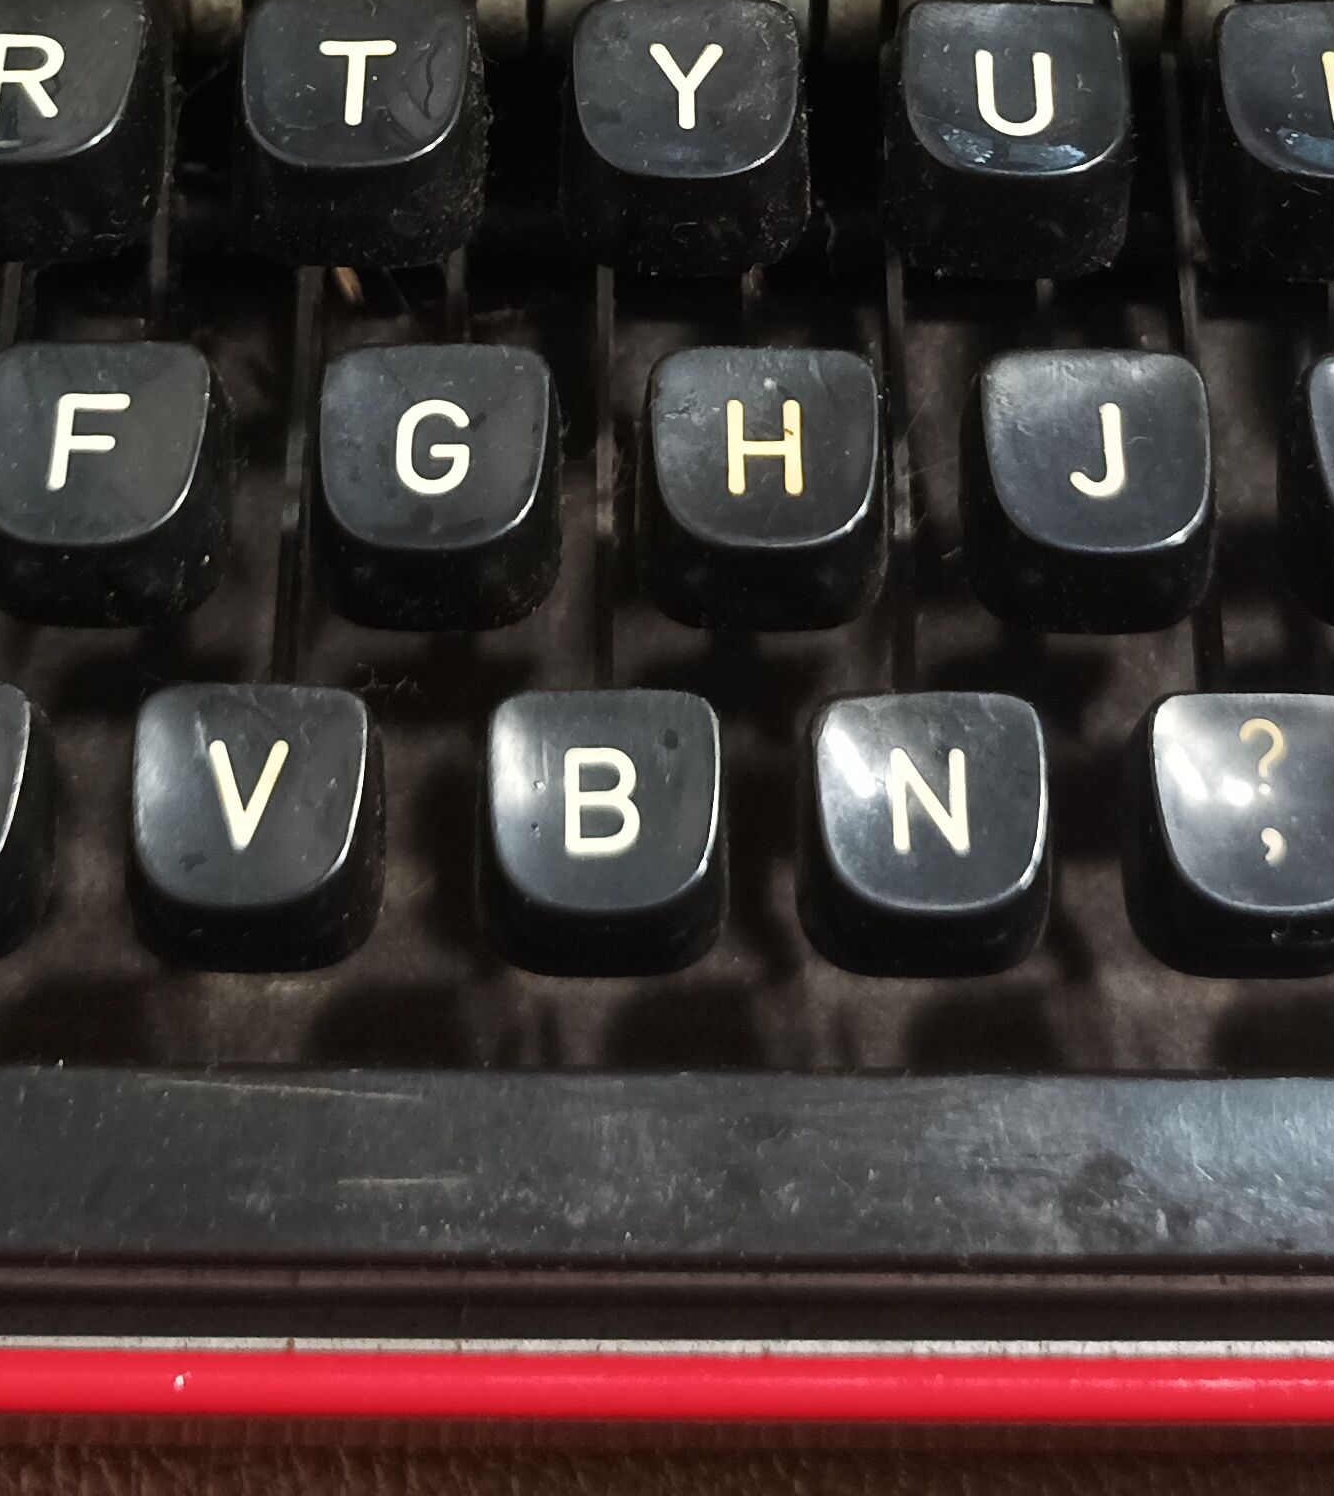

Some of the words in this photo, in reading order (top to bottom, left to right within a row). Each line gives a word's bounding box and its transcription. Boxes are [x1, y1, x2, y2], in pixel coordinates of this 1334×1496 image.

[319, 39, 397, 126] T
[649, 43, 724, 130] Y
[974, 49, 1054, 137] U
[47, 393, 131, 491] F
[395, 399, 470, 495] G
[726, 399, 803, 495] H
[1069, 402, 1126, 498] J
[208, 739, 289, 850] V
[562, 747, 641, 856] B
[887, 744, 975, 858] N
[1235, 714, 1291, 800] ?
